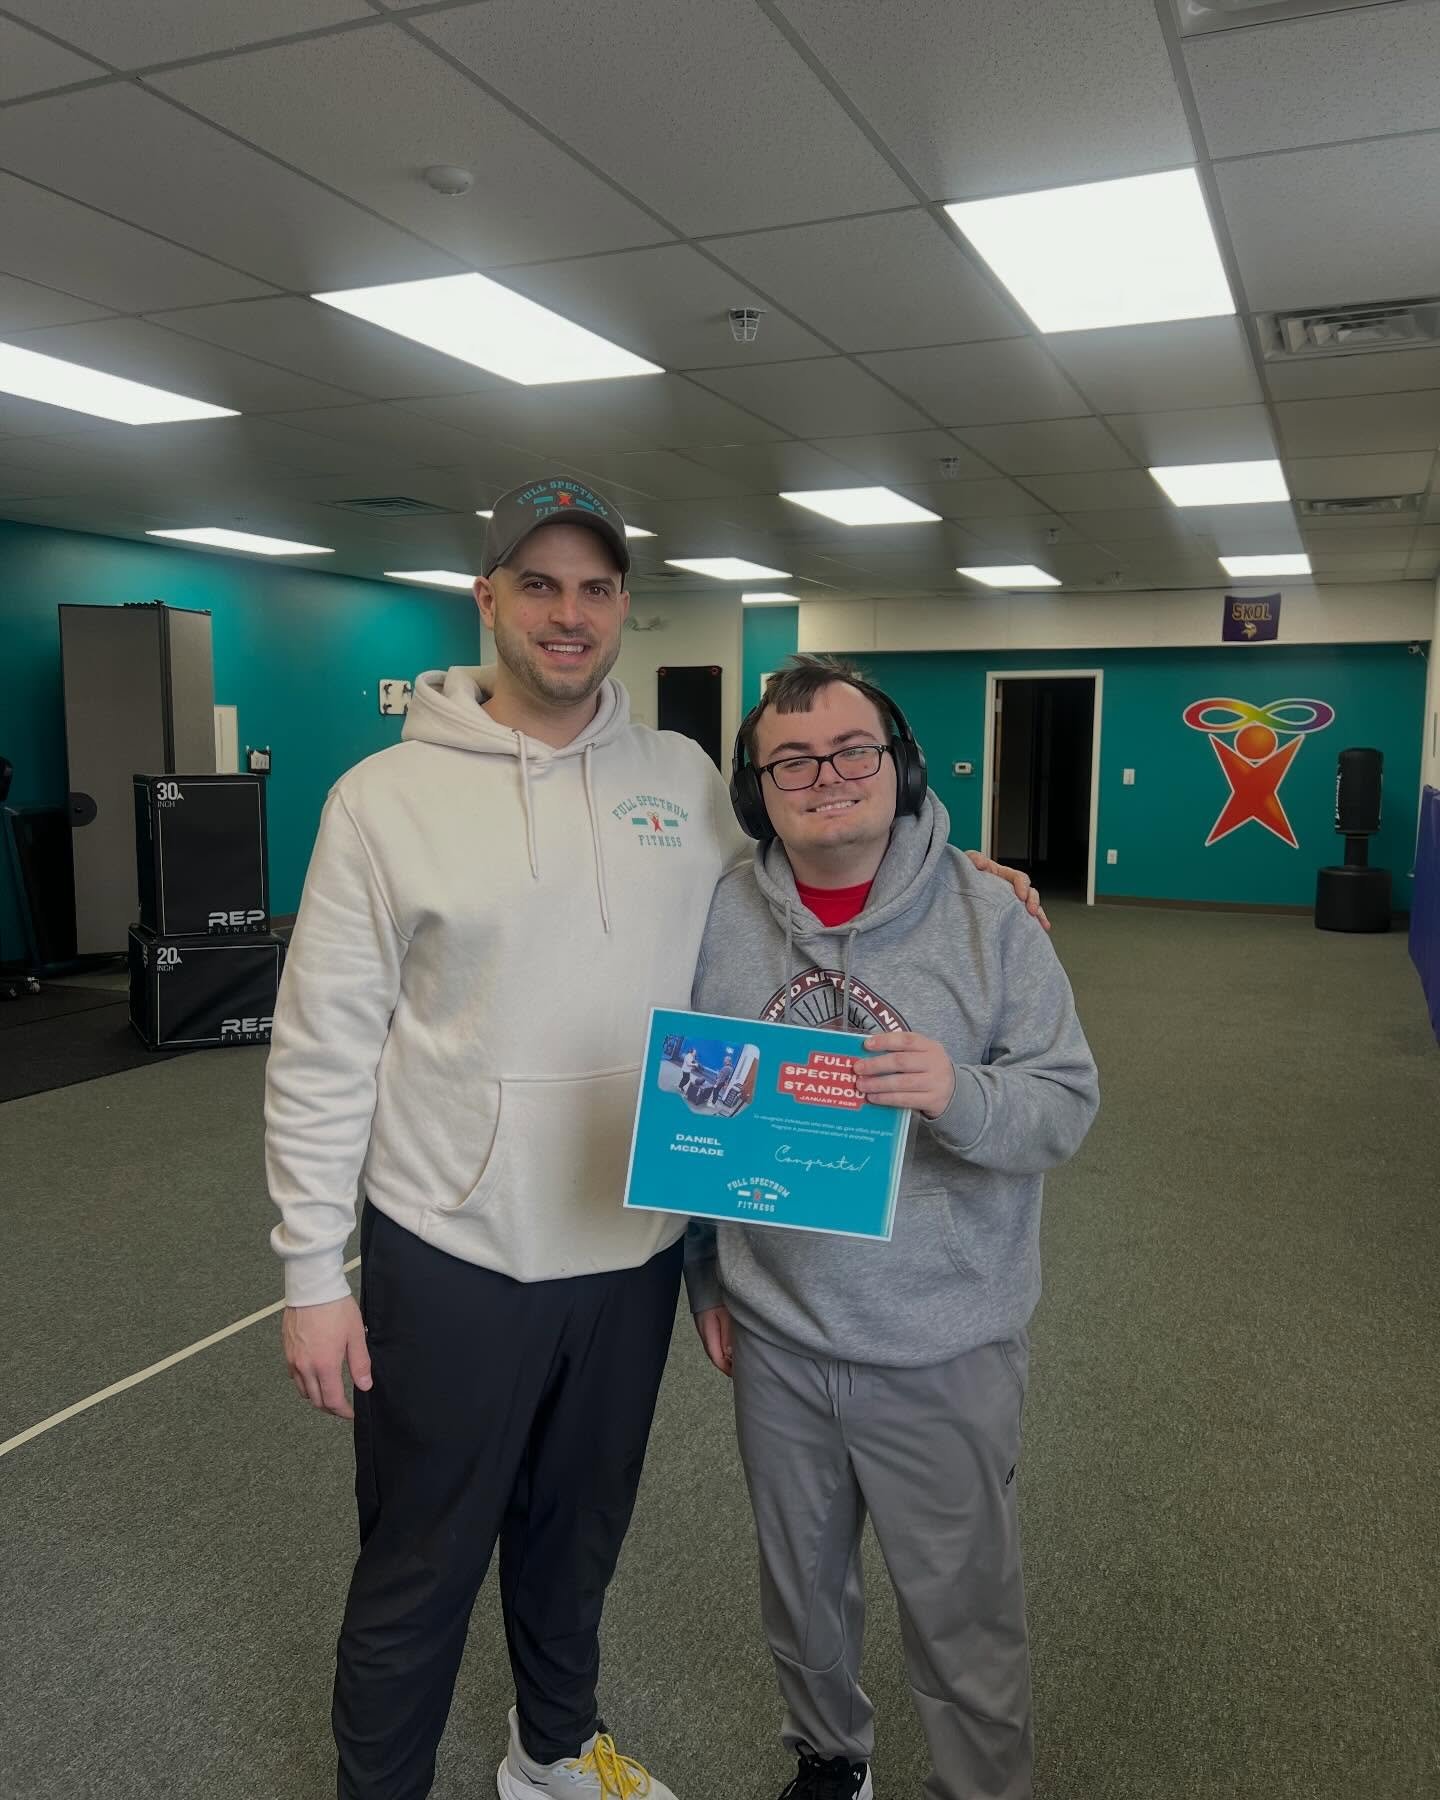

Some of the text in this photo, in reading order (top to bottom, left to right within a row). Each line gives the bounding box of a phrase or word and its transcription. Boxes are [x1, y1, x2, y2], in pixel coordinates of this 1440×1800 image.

[517, 485, 546, 505] FULL
[550, 480, 609, 515] SPECTRUM
[1231, 602, 1272, 621] SKOL
[156, 782, 179, 801] 30
[157, 800, 176, 808] INCH
[612, 795, 689, 822] FULL SPECTRUM
[638, 834, 682, 848] FITNESS
[208, 910, 266, 927] REP
[208, 925, 267, 935] FITNESS
[157, 947, 178, 965] 20
[156, 964, 174, 972] INCH
[221, 1032, 271, 1041] FITNES
[813, 1055, 853, 1068] FULL
[784, 1066, 857, 1083] SPECTR
[783, 1080, 866, 1099] STANDOU
[799, 1095, 837, 1104] JANUARY
[675, 1133, 722, 1146] DANIEL
[670, 1143, 725, 1157] MCDADE
[774, 1144, 871, 1172] Congrats!
[727, 1177, 790, 1198] FULL SPECTRUM
[737, 1200, 775, 1213] FITNESS
